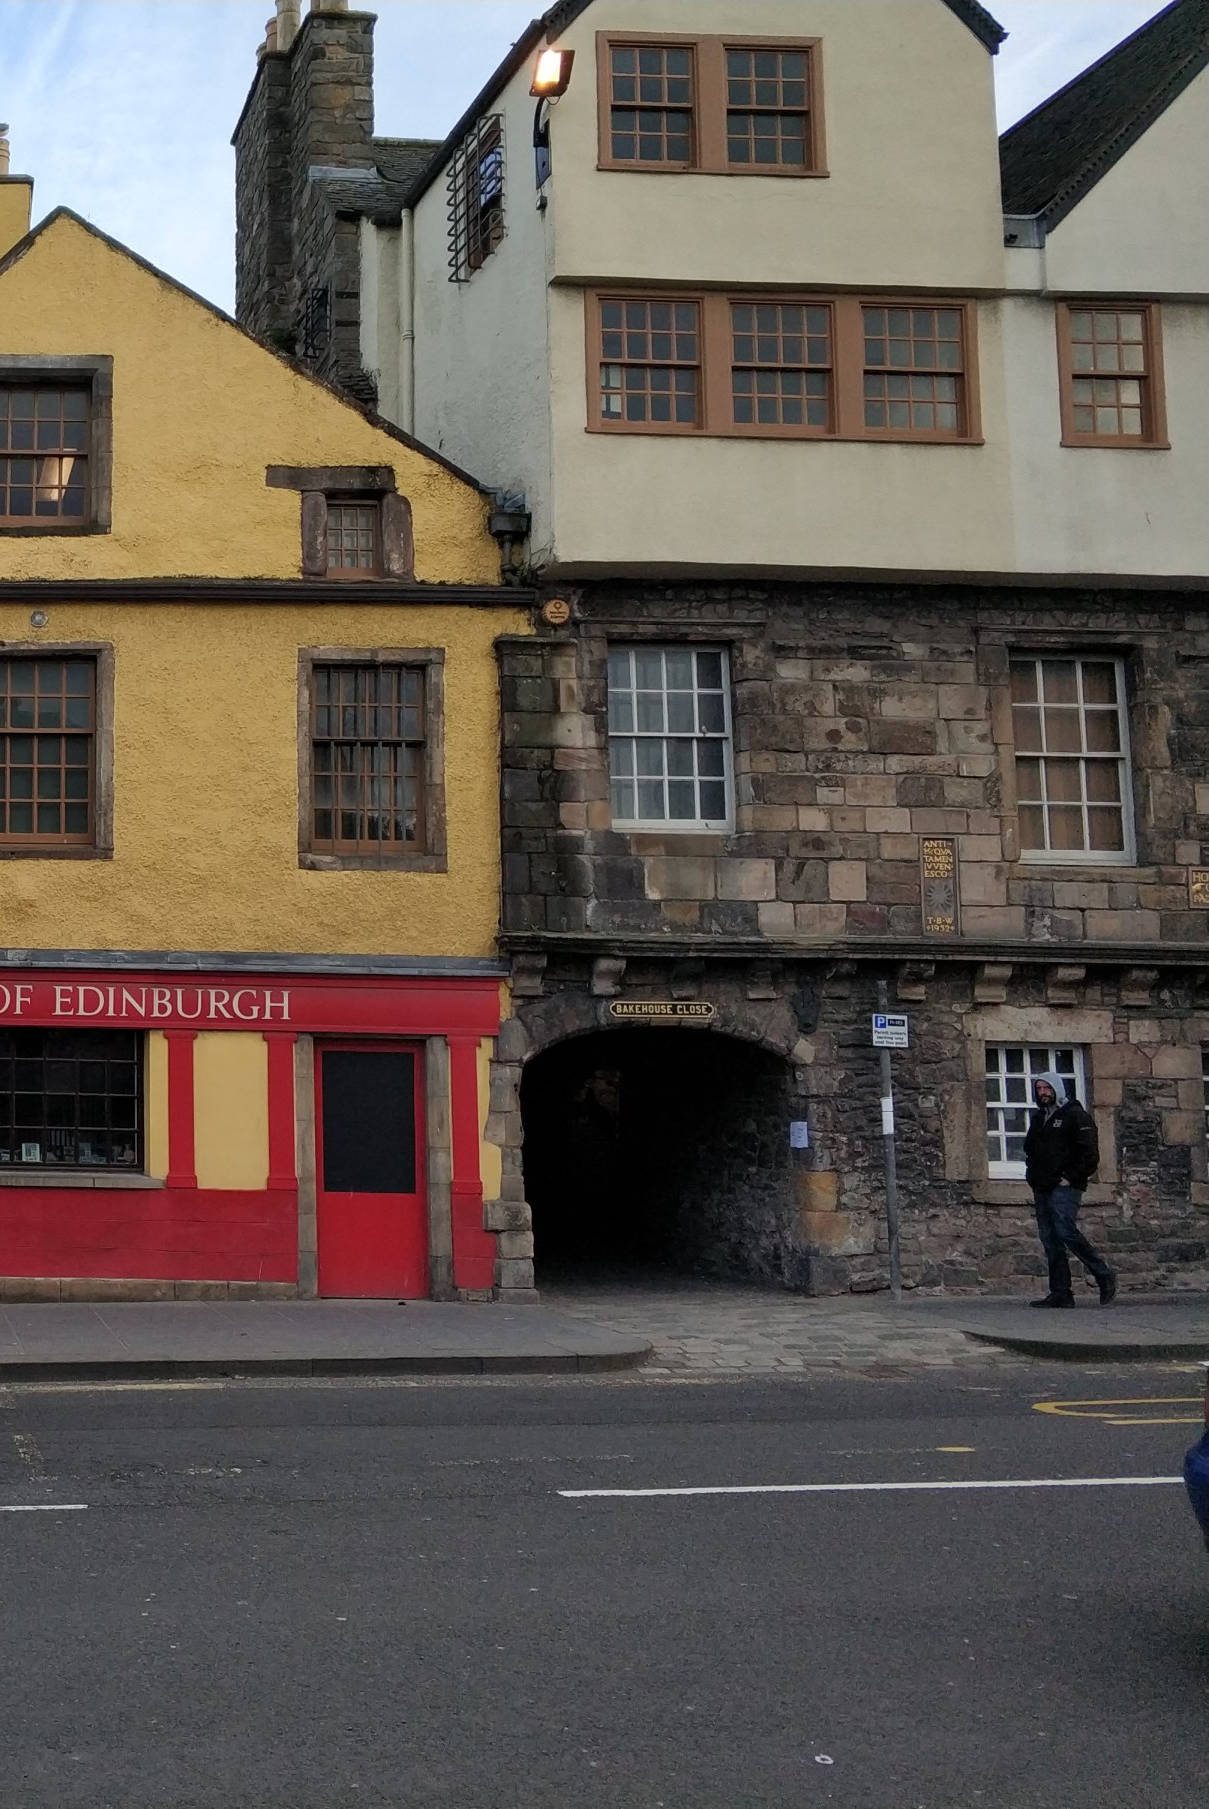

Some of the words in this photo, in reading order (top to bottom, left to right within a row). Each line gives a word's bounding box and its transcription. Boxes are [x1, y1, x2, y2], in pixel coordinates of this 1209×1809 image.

[923, 855, 954, 863] TAMEN
[51, 985, 292, 1020] EDINBURGH
[616, 1004, 673, 1014] BAKEHOUSE
[676, 1005, 708, 1014] CLOSE
